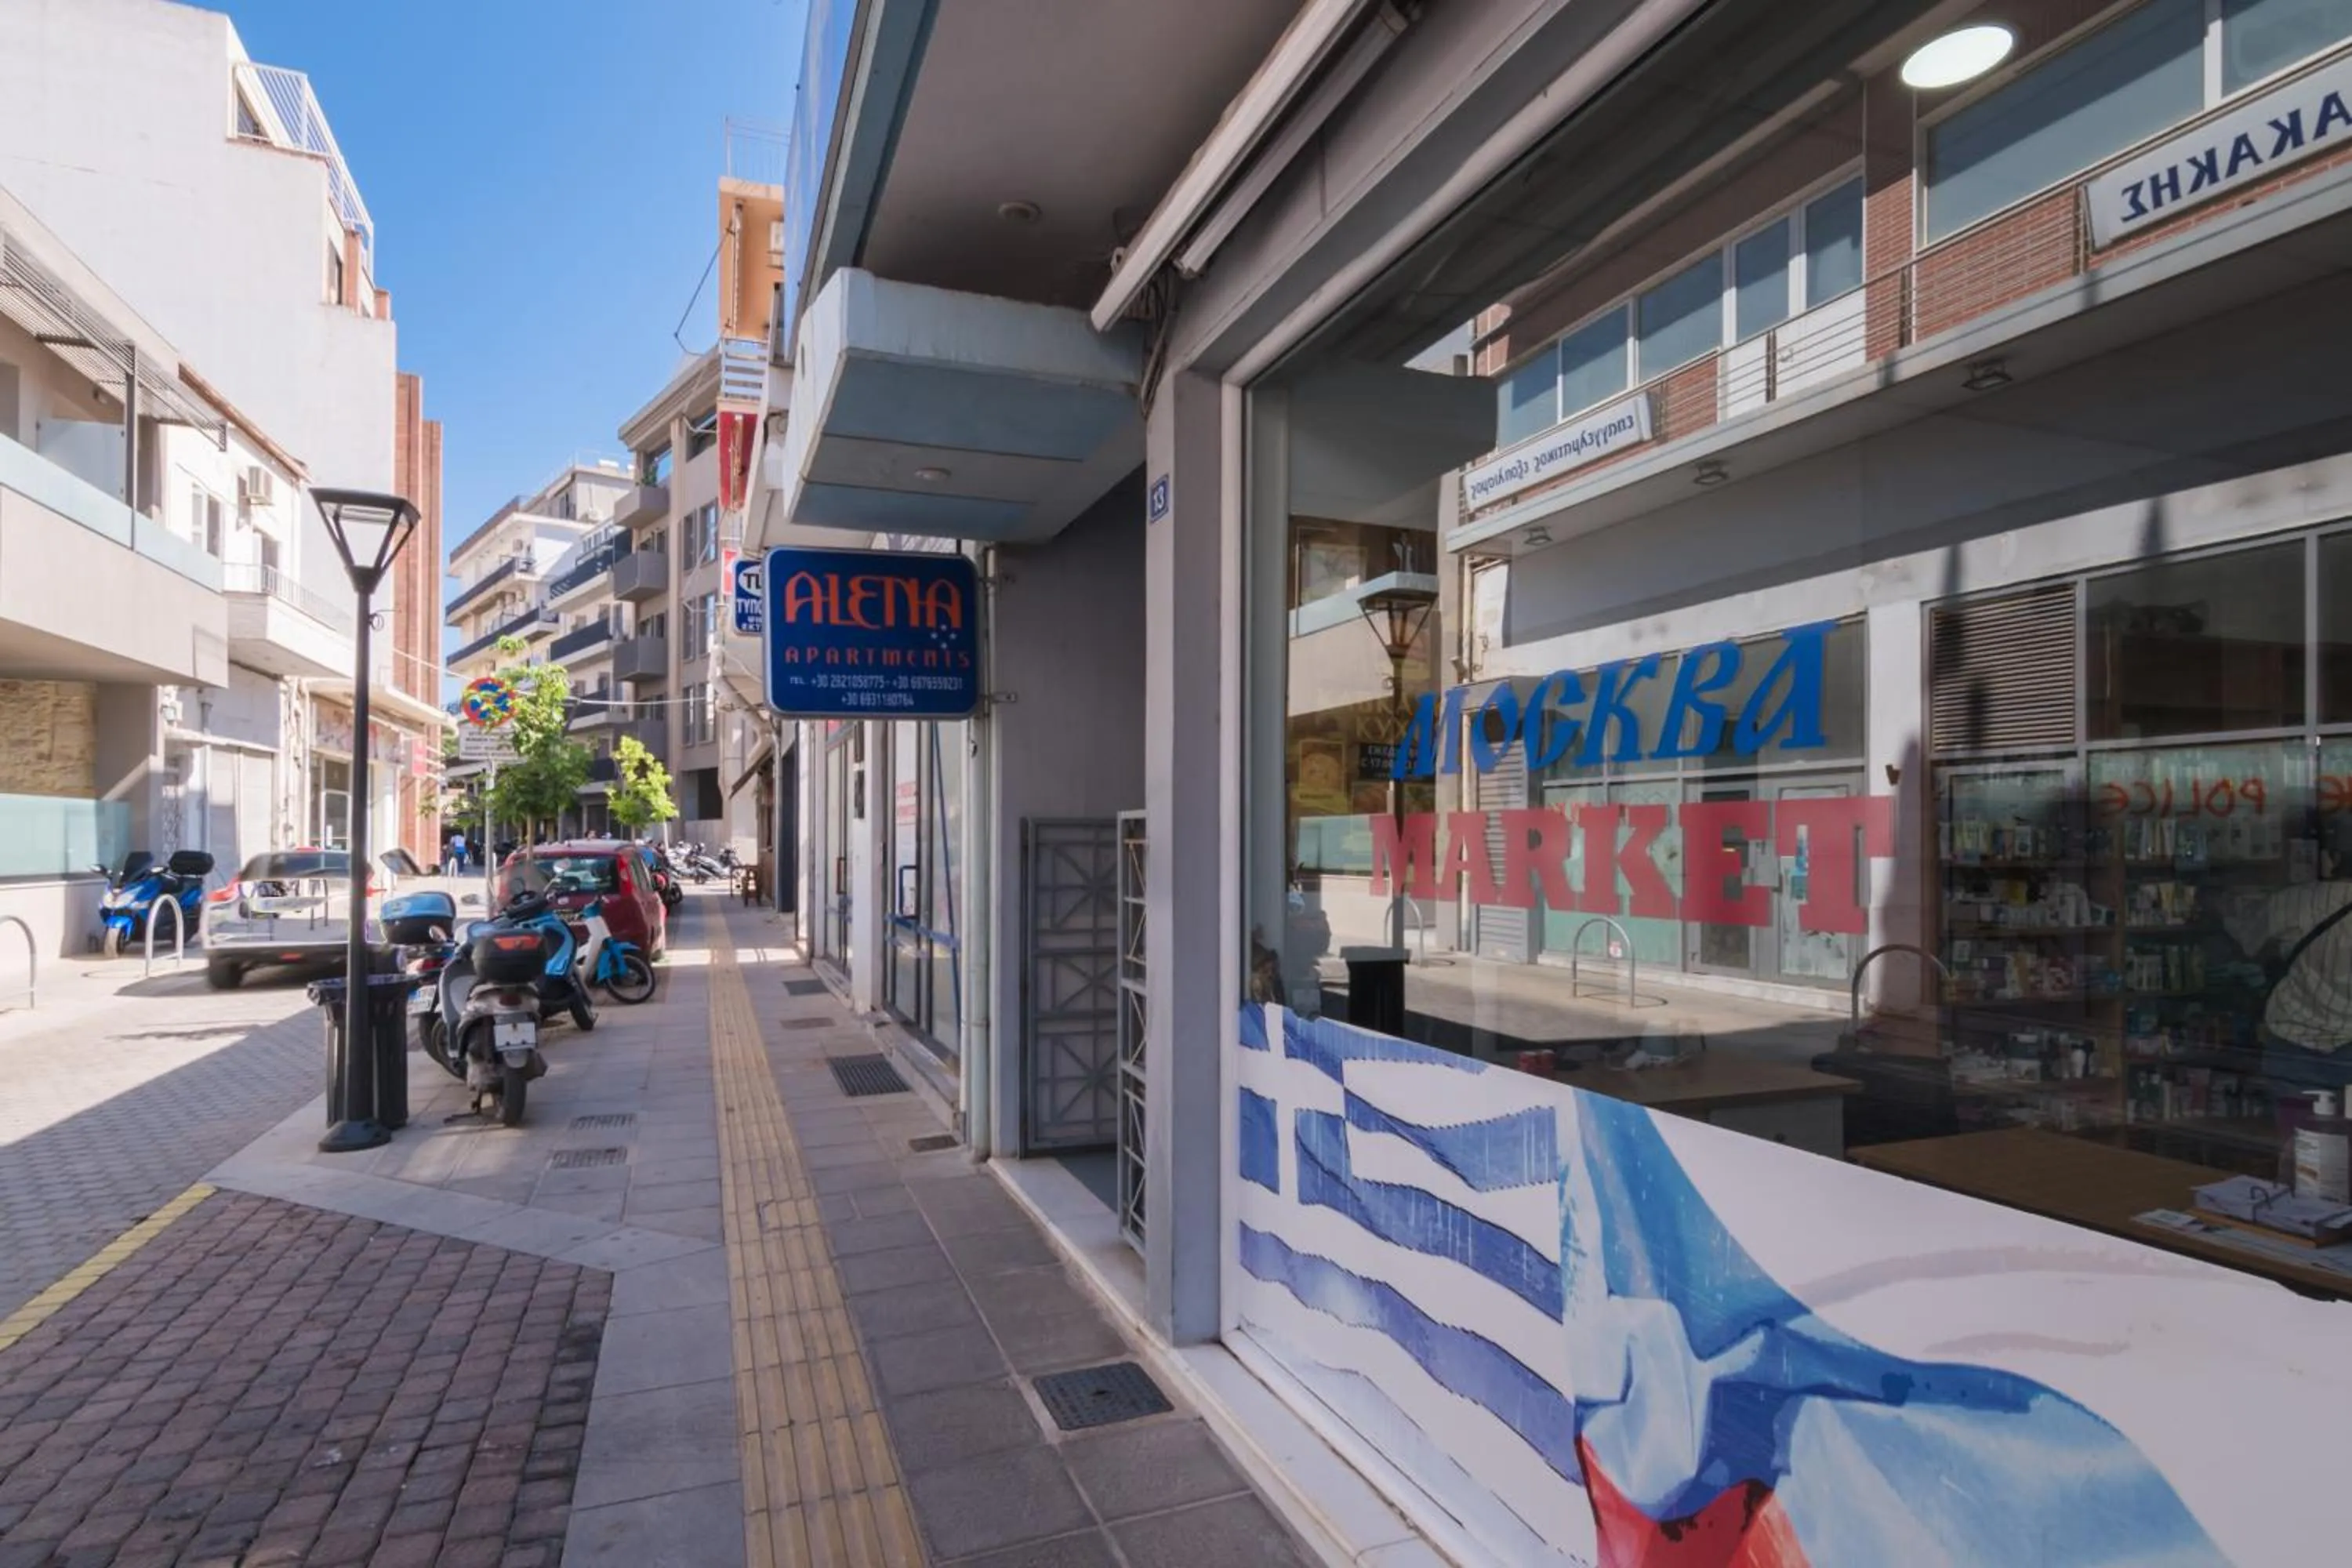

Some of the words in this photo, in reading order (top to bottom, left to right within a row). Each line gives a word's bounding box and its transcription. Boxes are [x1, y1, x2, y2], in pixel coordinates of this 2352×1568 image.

[786, 571, 962, 630] ALENA
[1390, 620, 1838, 781] МОСКВА
[1369, 795, 1896, 935] MARKET
